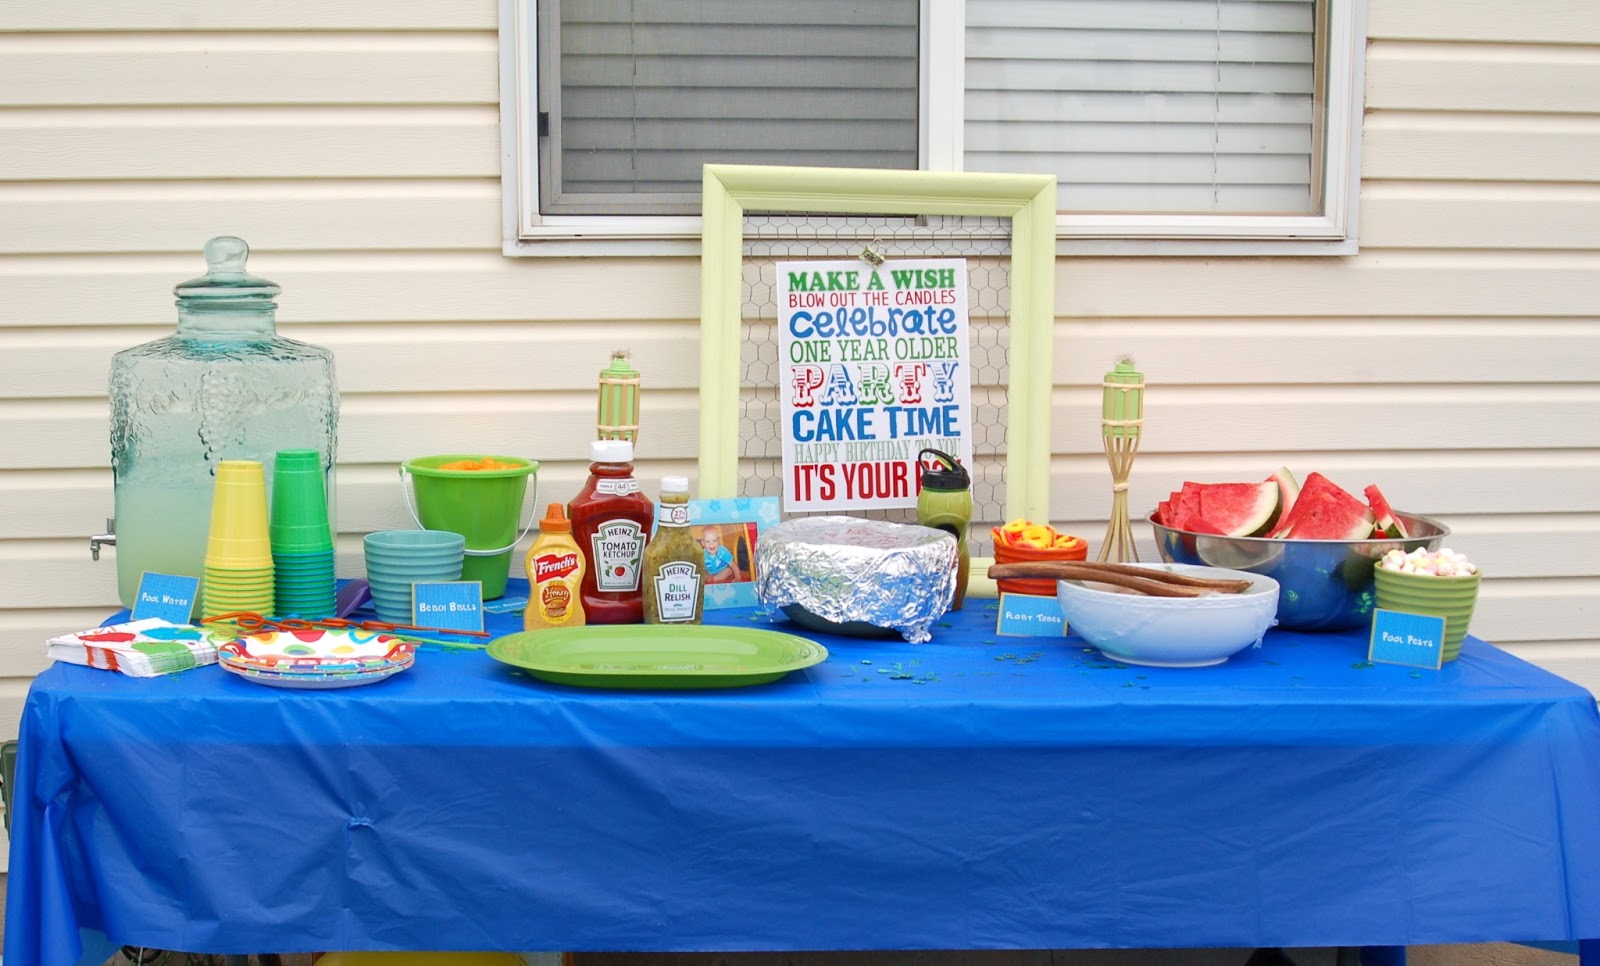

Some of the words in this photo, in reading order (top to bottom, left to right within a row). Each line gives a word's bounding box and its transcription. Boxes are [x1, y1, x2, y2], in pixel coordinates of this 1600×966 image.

[788, 271, 860, 292] MAKE
[866, 270, 885, 291] A
[891, 269, 955, 289] WISH
[789, 293, 825, 308] BLOW
[830, 292, 857, 307] OUT
[862, 292, 889, 306] THE
[895, 290, 956, 305] CANDLES
[789, 306, 957, 338] celebrate
[790, 339, 832, 363] ONE
[837, 338, 889, 362] YEAR
[895, 337, 959, 360] OLDER
[791, 360, 959, 408] PARTY
[792, 407, 876, 442] CAKE
[883, 405, 961, 439] TIME
[794, 443, 840, 464] HAPPY
[845, 440, 911, 462] BIRTHDAY
[915, 440, 934, 460] TO
[936, 438, 961, 459] YOU
[794, 463, 836, 501] IT'S
[841, 462, 909, 500] YOUR
[608, 528, 633, 537] HEINZ
[602, 542, 637, 551] TOMATO
[603, 550, 636, 558] KETCHUP
[538, 556, 576, 576] French's
[666, 566, 690, 577] HEINZ
[665, 593, 691, 602] RELISH
[669, 583, 687, 593] DILL
[1382, 631, 1404, 644] POOL
